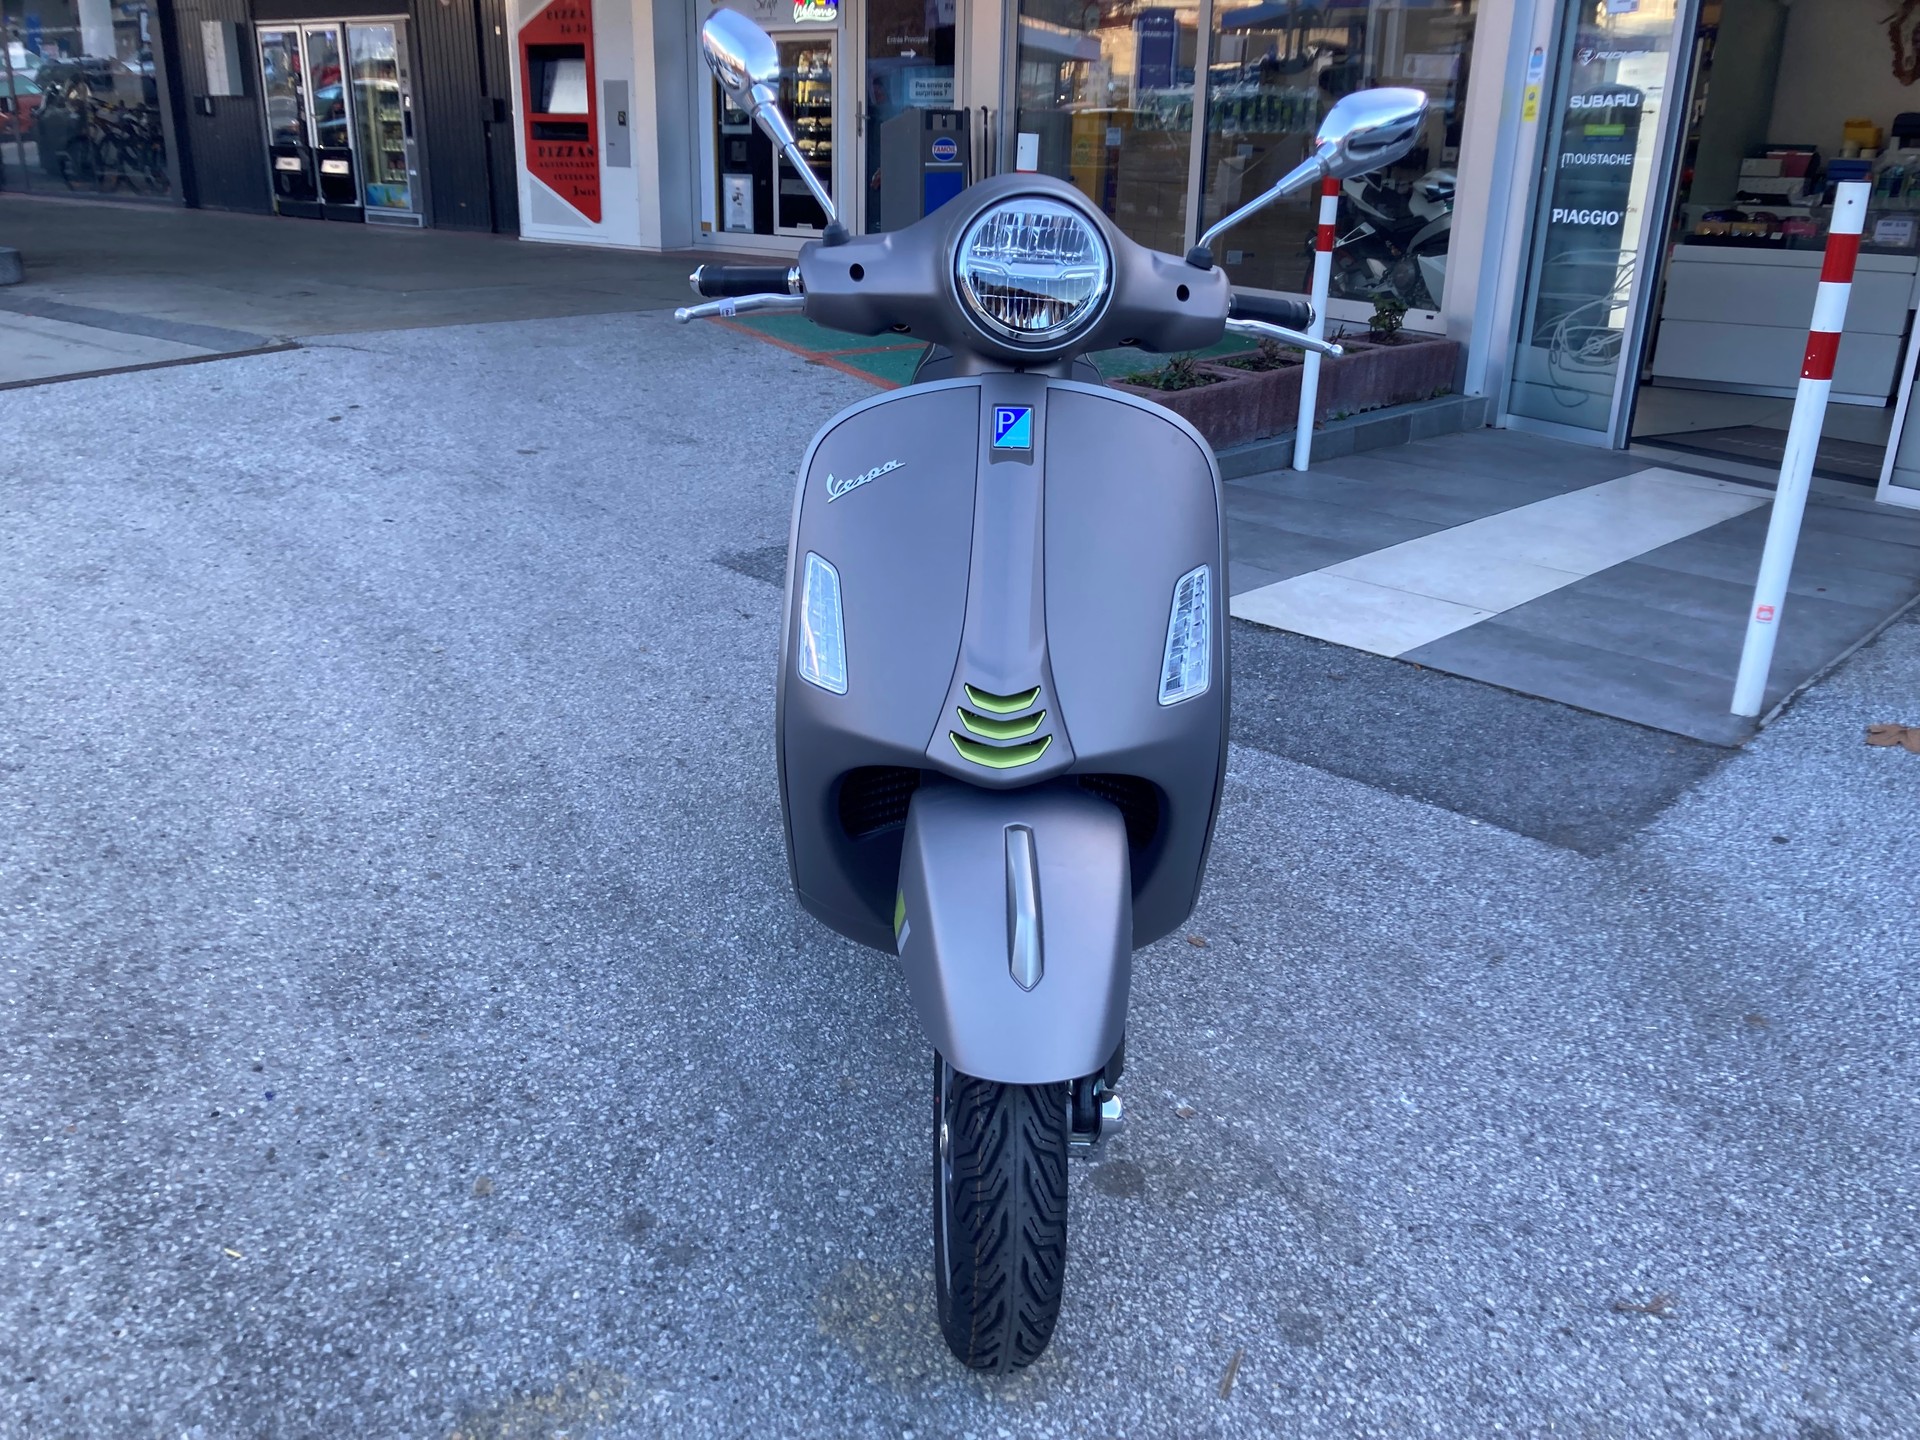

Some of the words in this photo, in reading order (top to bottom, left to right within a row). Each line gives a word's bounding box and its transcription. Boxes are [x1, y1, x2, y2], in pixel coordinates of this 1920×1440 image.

[793, 2, 837, 23] Welcome
[915, 81, 926, 89] Pas
[915, 90, 943, 98] surprises
[1569, 94, 1639, 108] SUBARU
[538, 146, 594, 158] PIZZAS
[1561, 152, 1632, 168] MOUSTACHE
[1552, 208, 1620, 226] PIAGGIO
[997, 411, 1016, 434] P
[826, 459, 906, 504] Vespa
